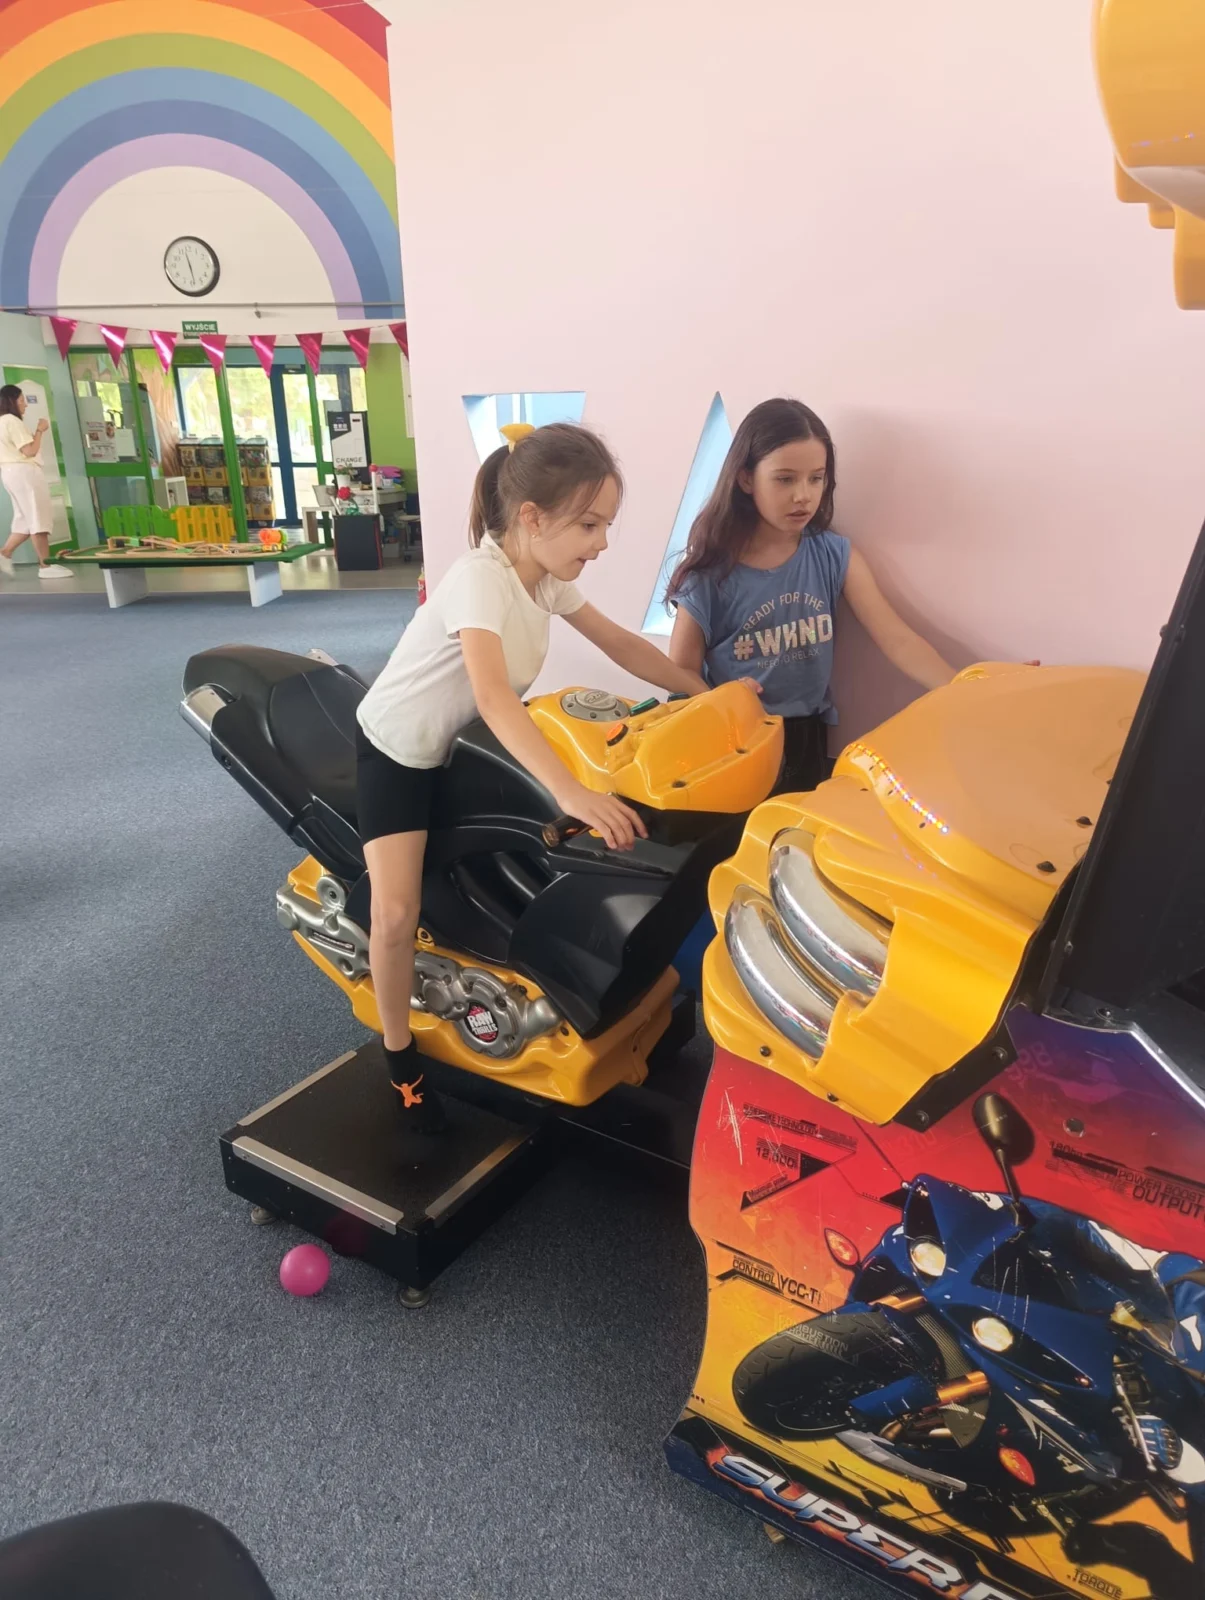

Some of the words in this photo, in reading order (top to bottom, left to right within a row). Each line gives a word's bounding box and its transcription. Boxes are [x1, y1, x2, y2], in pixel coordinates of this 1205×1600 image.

[184, 322, 216, 331] WYJŚCIE
[335, 456, 363, 464] CHANGE
[743, 599, 775, 632] READY
[779, 591, 800, 606] FOR
[803, 592, 825, 612] THE
[733, 613, 833, 661] #WKND
[792, 647, 821, 663] RELAX
[467, 1010, 494, 1028] RAW
[1117, 1169, 1162, 1190] POWER
[1163, 1183, 1205, 1203] BOOST
[1133, 1184, 1204, 1219] OUTPUT
[732, 1258, 776, 1285] CONTROL
[712, 1453, 967, 1593] SUPER
[1074, 1567, 1123, 1599] TORQUE
